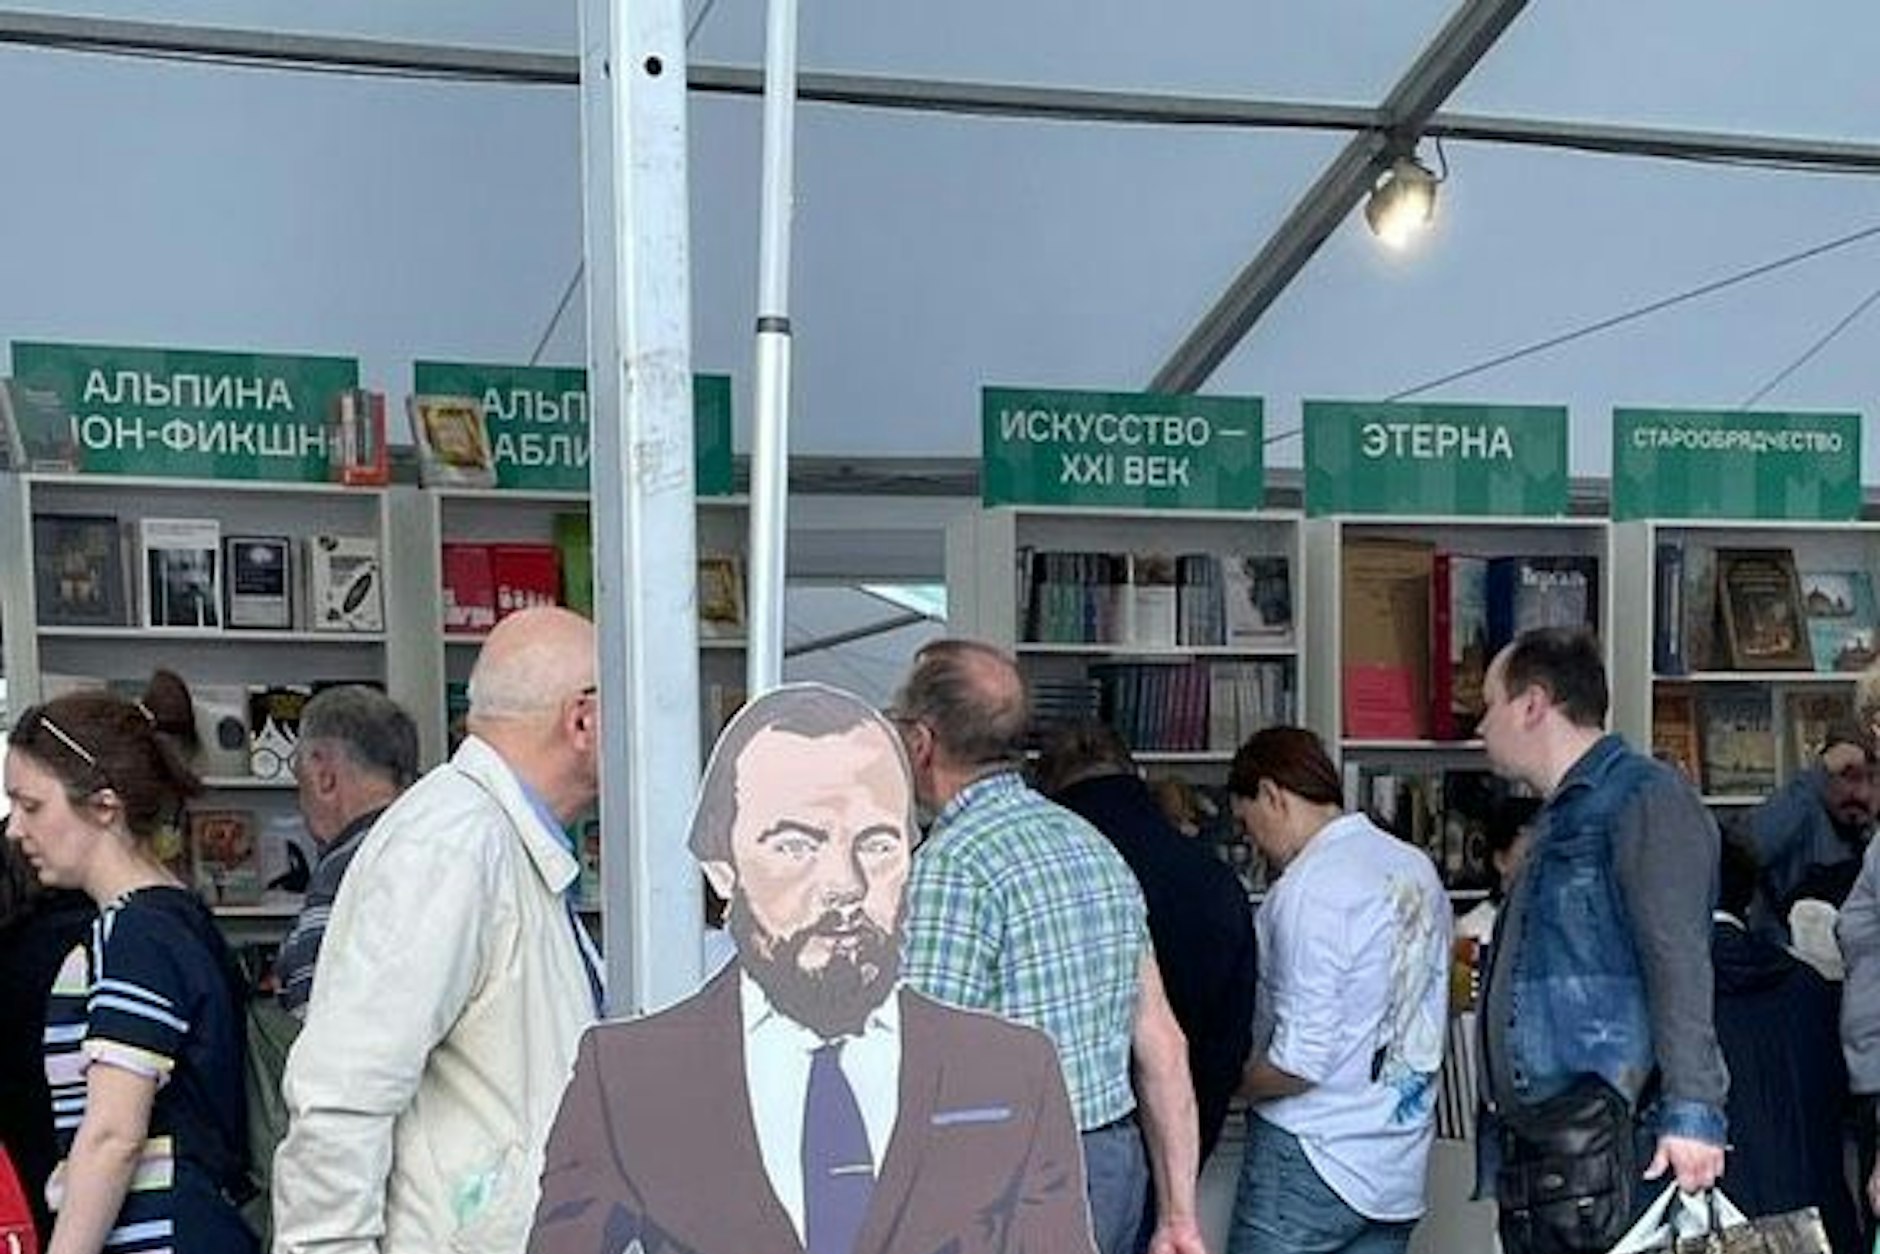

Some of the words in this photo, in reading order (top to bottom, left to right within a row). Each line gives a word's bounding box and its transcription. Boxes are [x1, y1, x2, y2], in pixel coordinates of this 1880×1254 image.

[83, 368, 293, 412] АЛЬПИНА
[482, 387, 588, 424] АЛЬП
[70, 413, 327, 458] ОН-ФИКШН
[1000, 409, 1211, 447] ИСКУССТВО
[1361, 423, 1514, 459] ЭТЕРНА
[1633, 427, 1843, 453] СТАРООБРЯДЧЕСТВО
[494, 432, 591, 468] АБЛИ
[1123, 455, 1190, 488] ВЕК
